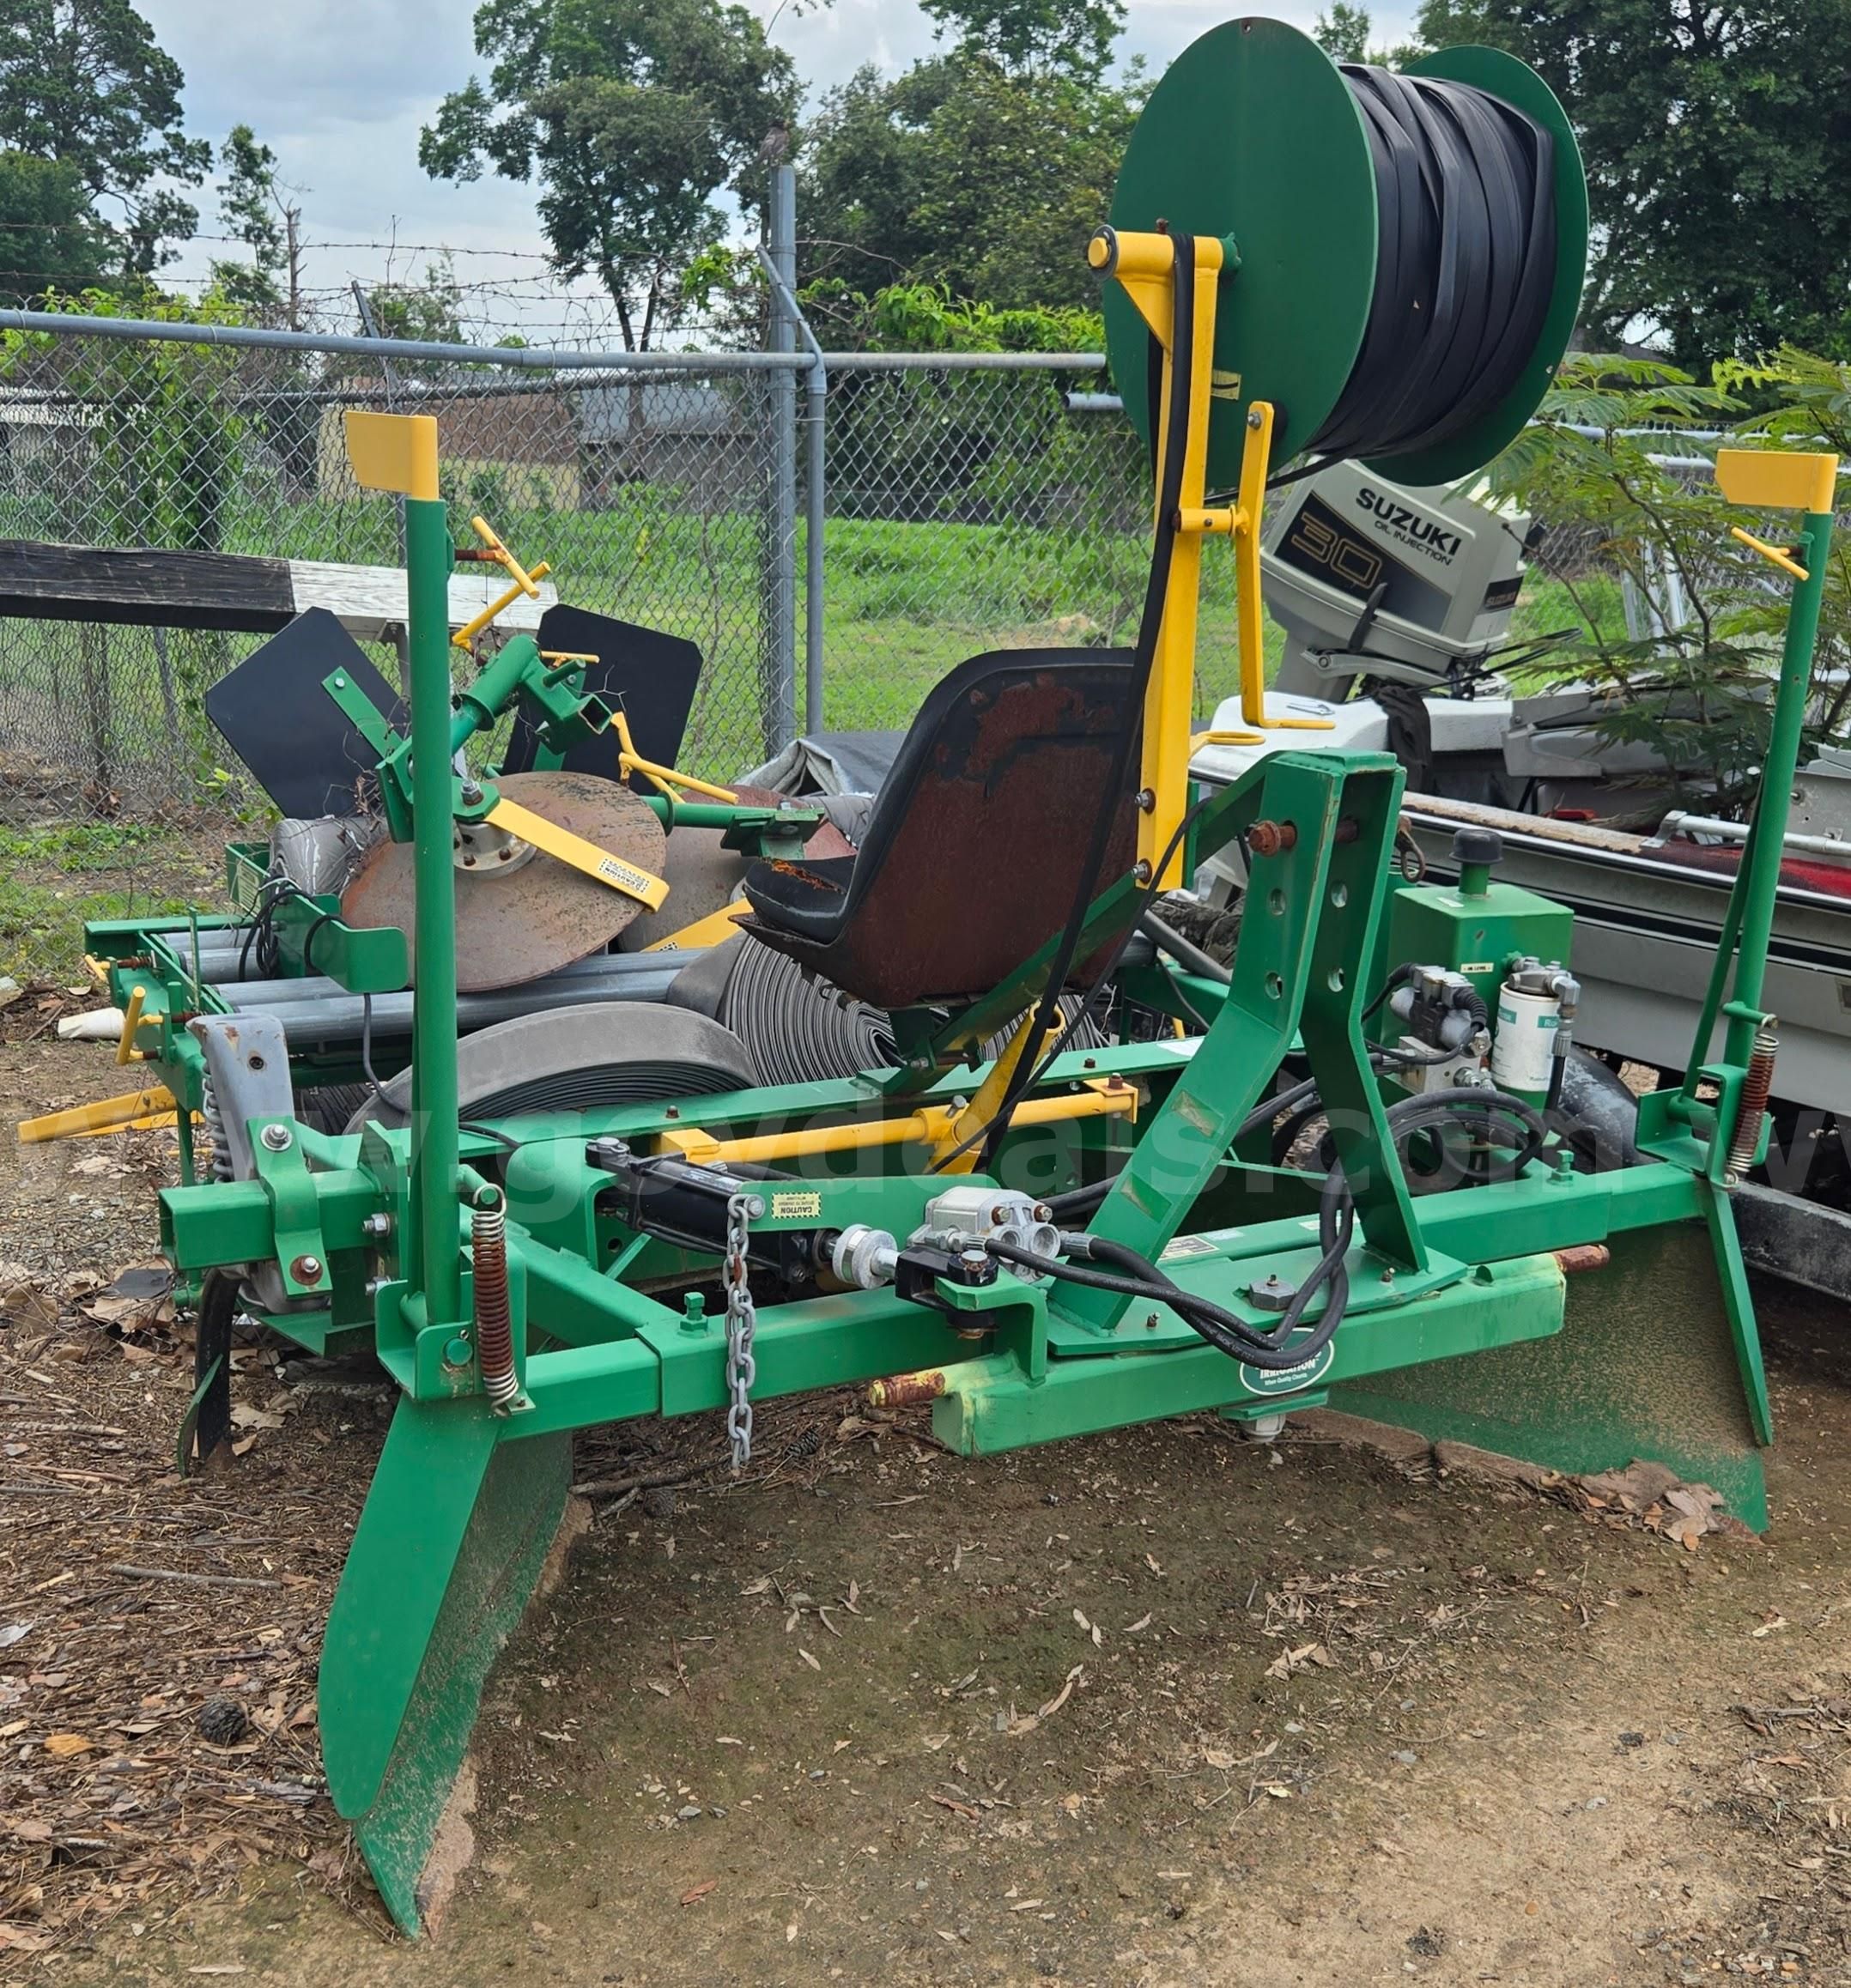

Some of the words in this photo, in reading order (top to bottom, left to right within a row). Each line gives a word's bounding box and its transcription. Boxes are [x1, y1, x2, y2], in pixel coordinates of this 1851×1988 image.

[1290, 512, 1383, 589] 30
[1356, 488, 1462, 556] SUZUKI
[1374, 520, 1393, 537] OIL
[1393, 530, 1453, 567] INJECTION
[780, 1205, 812, 1214] CAUTION
